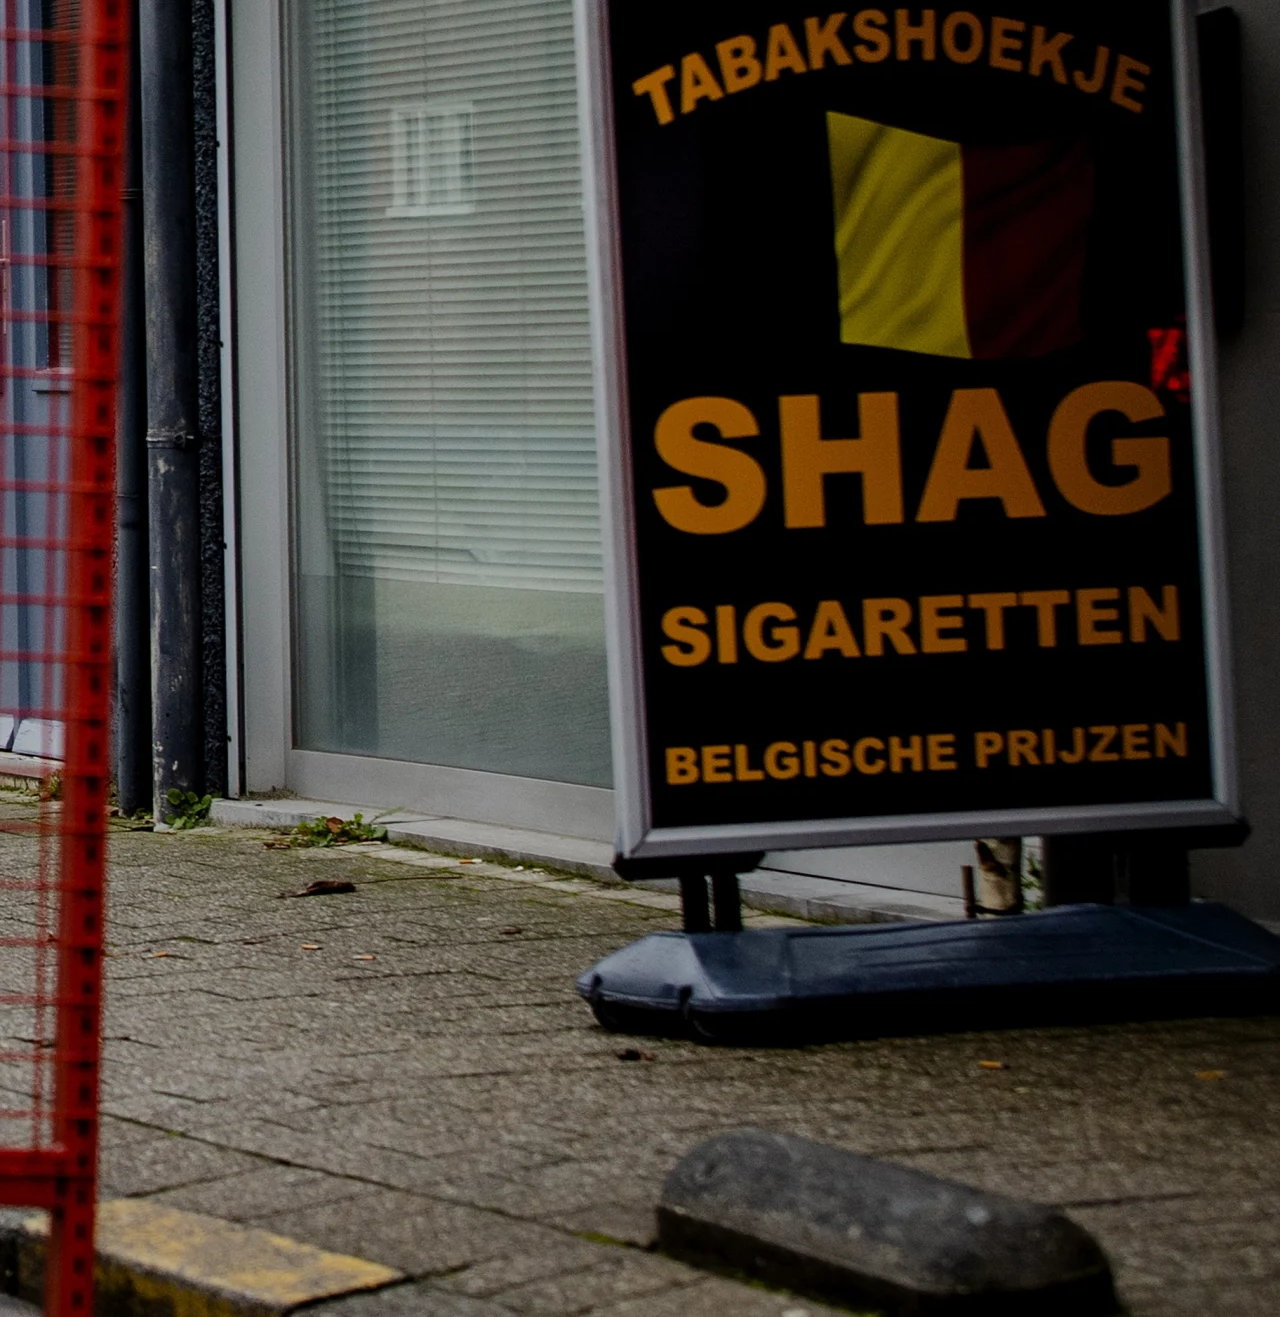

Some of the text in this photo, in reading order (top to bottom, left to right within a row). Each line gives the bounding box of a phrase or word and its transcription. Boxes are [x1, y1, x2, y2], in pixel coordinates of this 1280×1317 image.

[633, 8, 1151, 125] TABAKSHOEKJE
[652, 380, 1172, 535] SHAG
[660, 584, 1182, 668] SIGARETTEN
[665, 721, 1188, 785] BELGISCHE PRIJZEN
